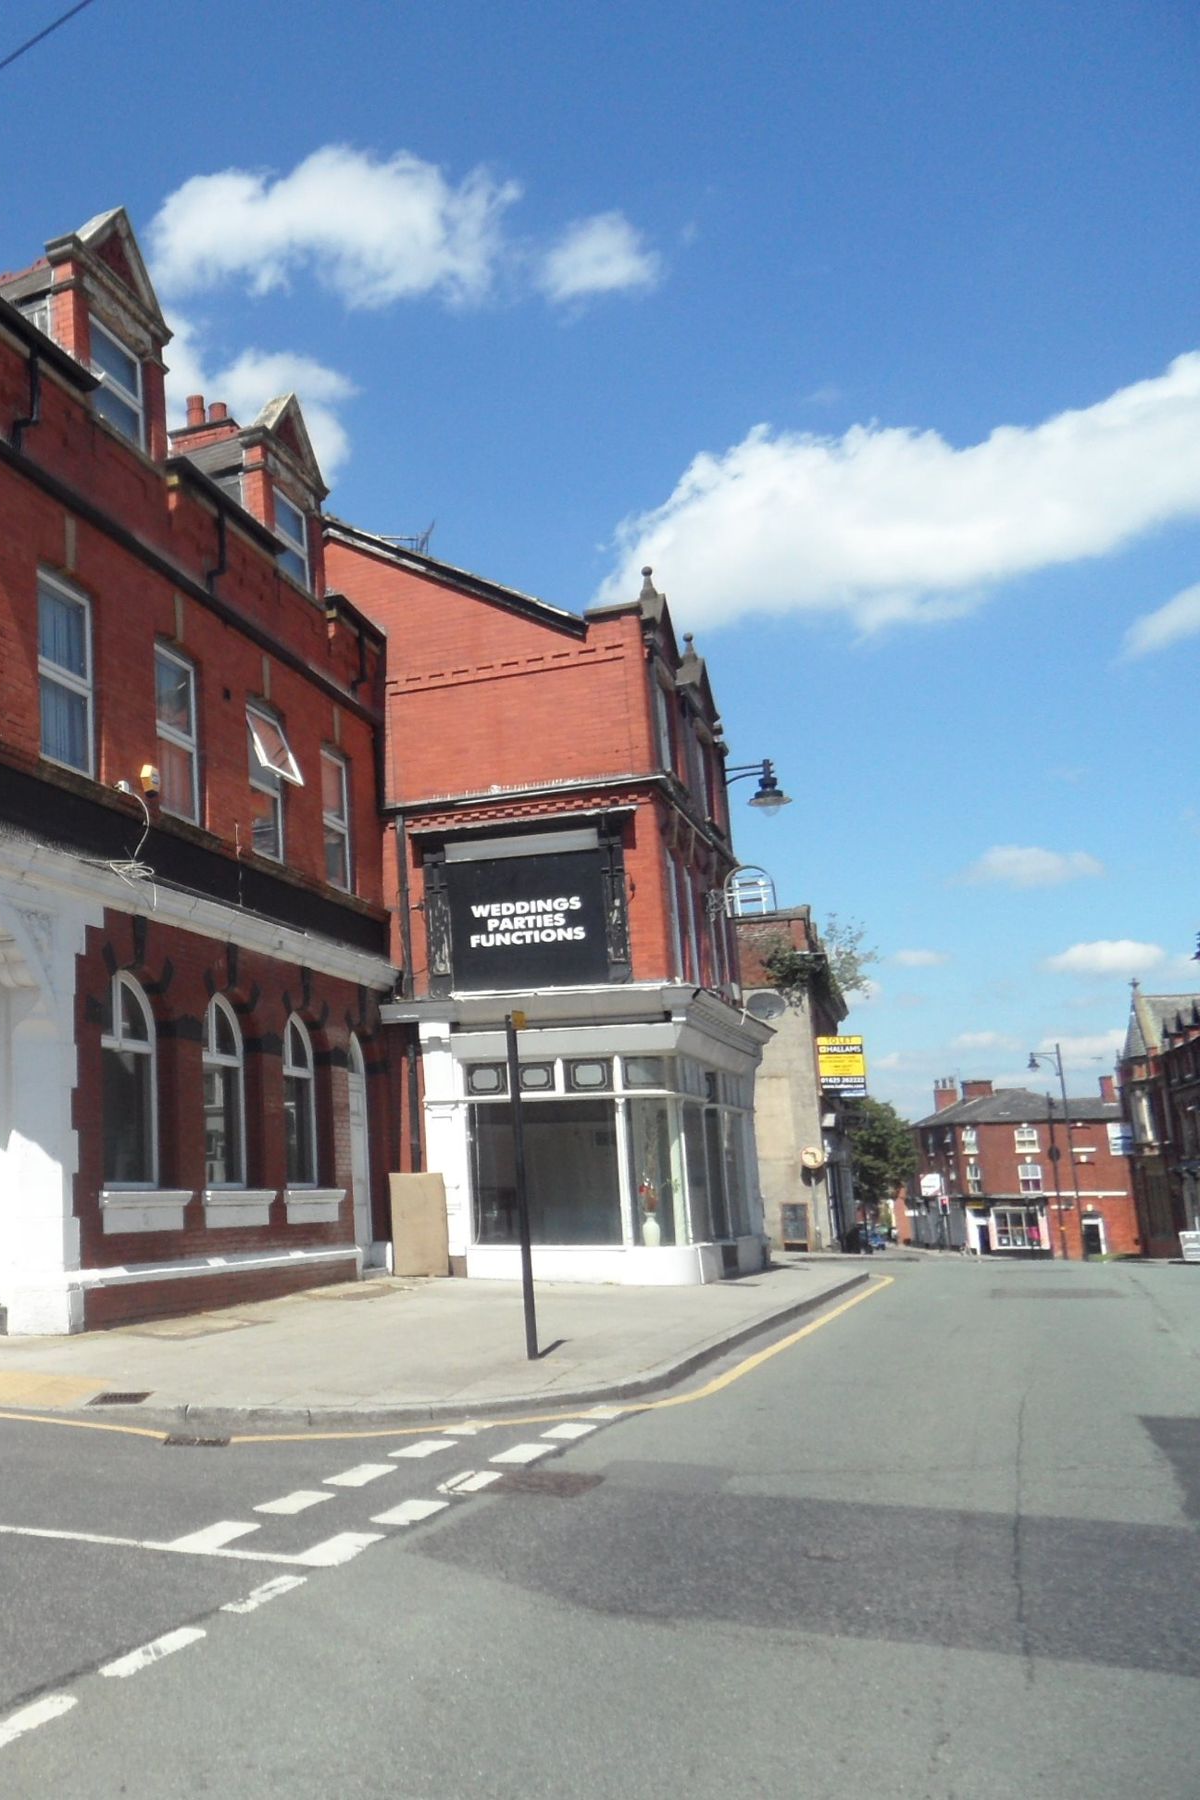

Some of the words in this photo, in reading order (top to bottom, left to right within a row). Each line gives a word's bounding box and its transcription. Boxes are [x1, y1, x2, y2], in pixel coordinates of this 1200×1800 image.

[471, 896, 582, 918] WEDDINGS
[487, 913, 566, 932] PARTIES
[470, 927, 586, 948] FUNCTIONS
[838, 1036, 852, 1044] LET
